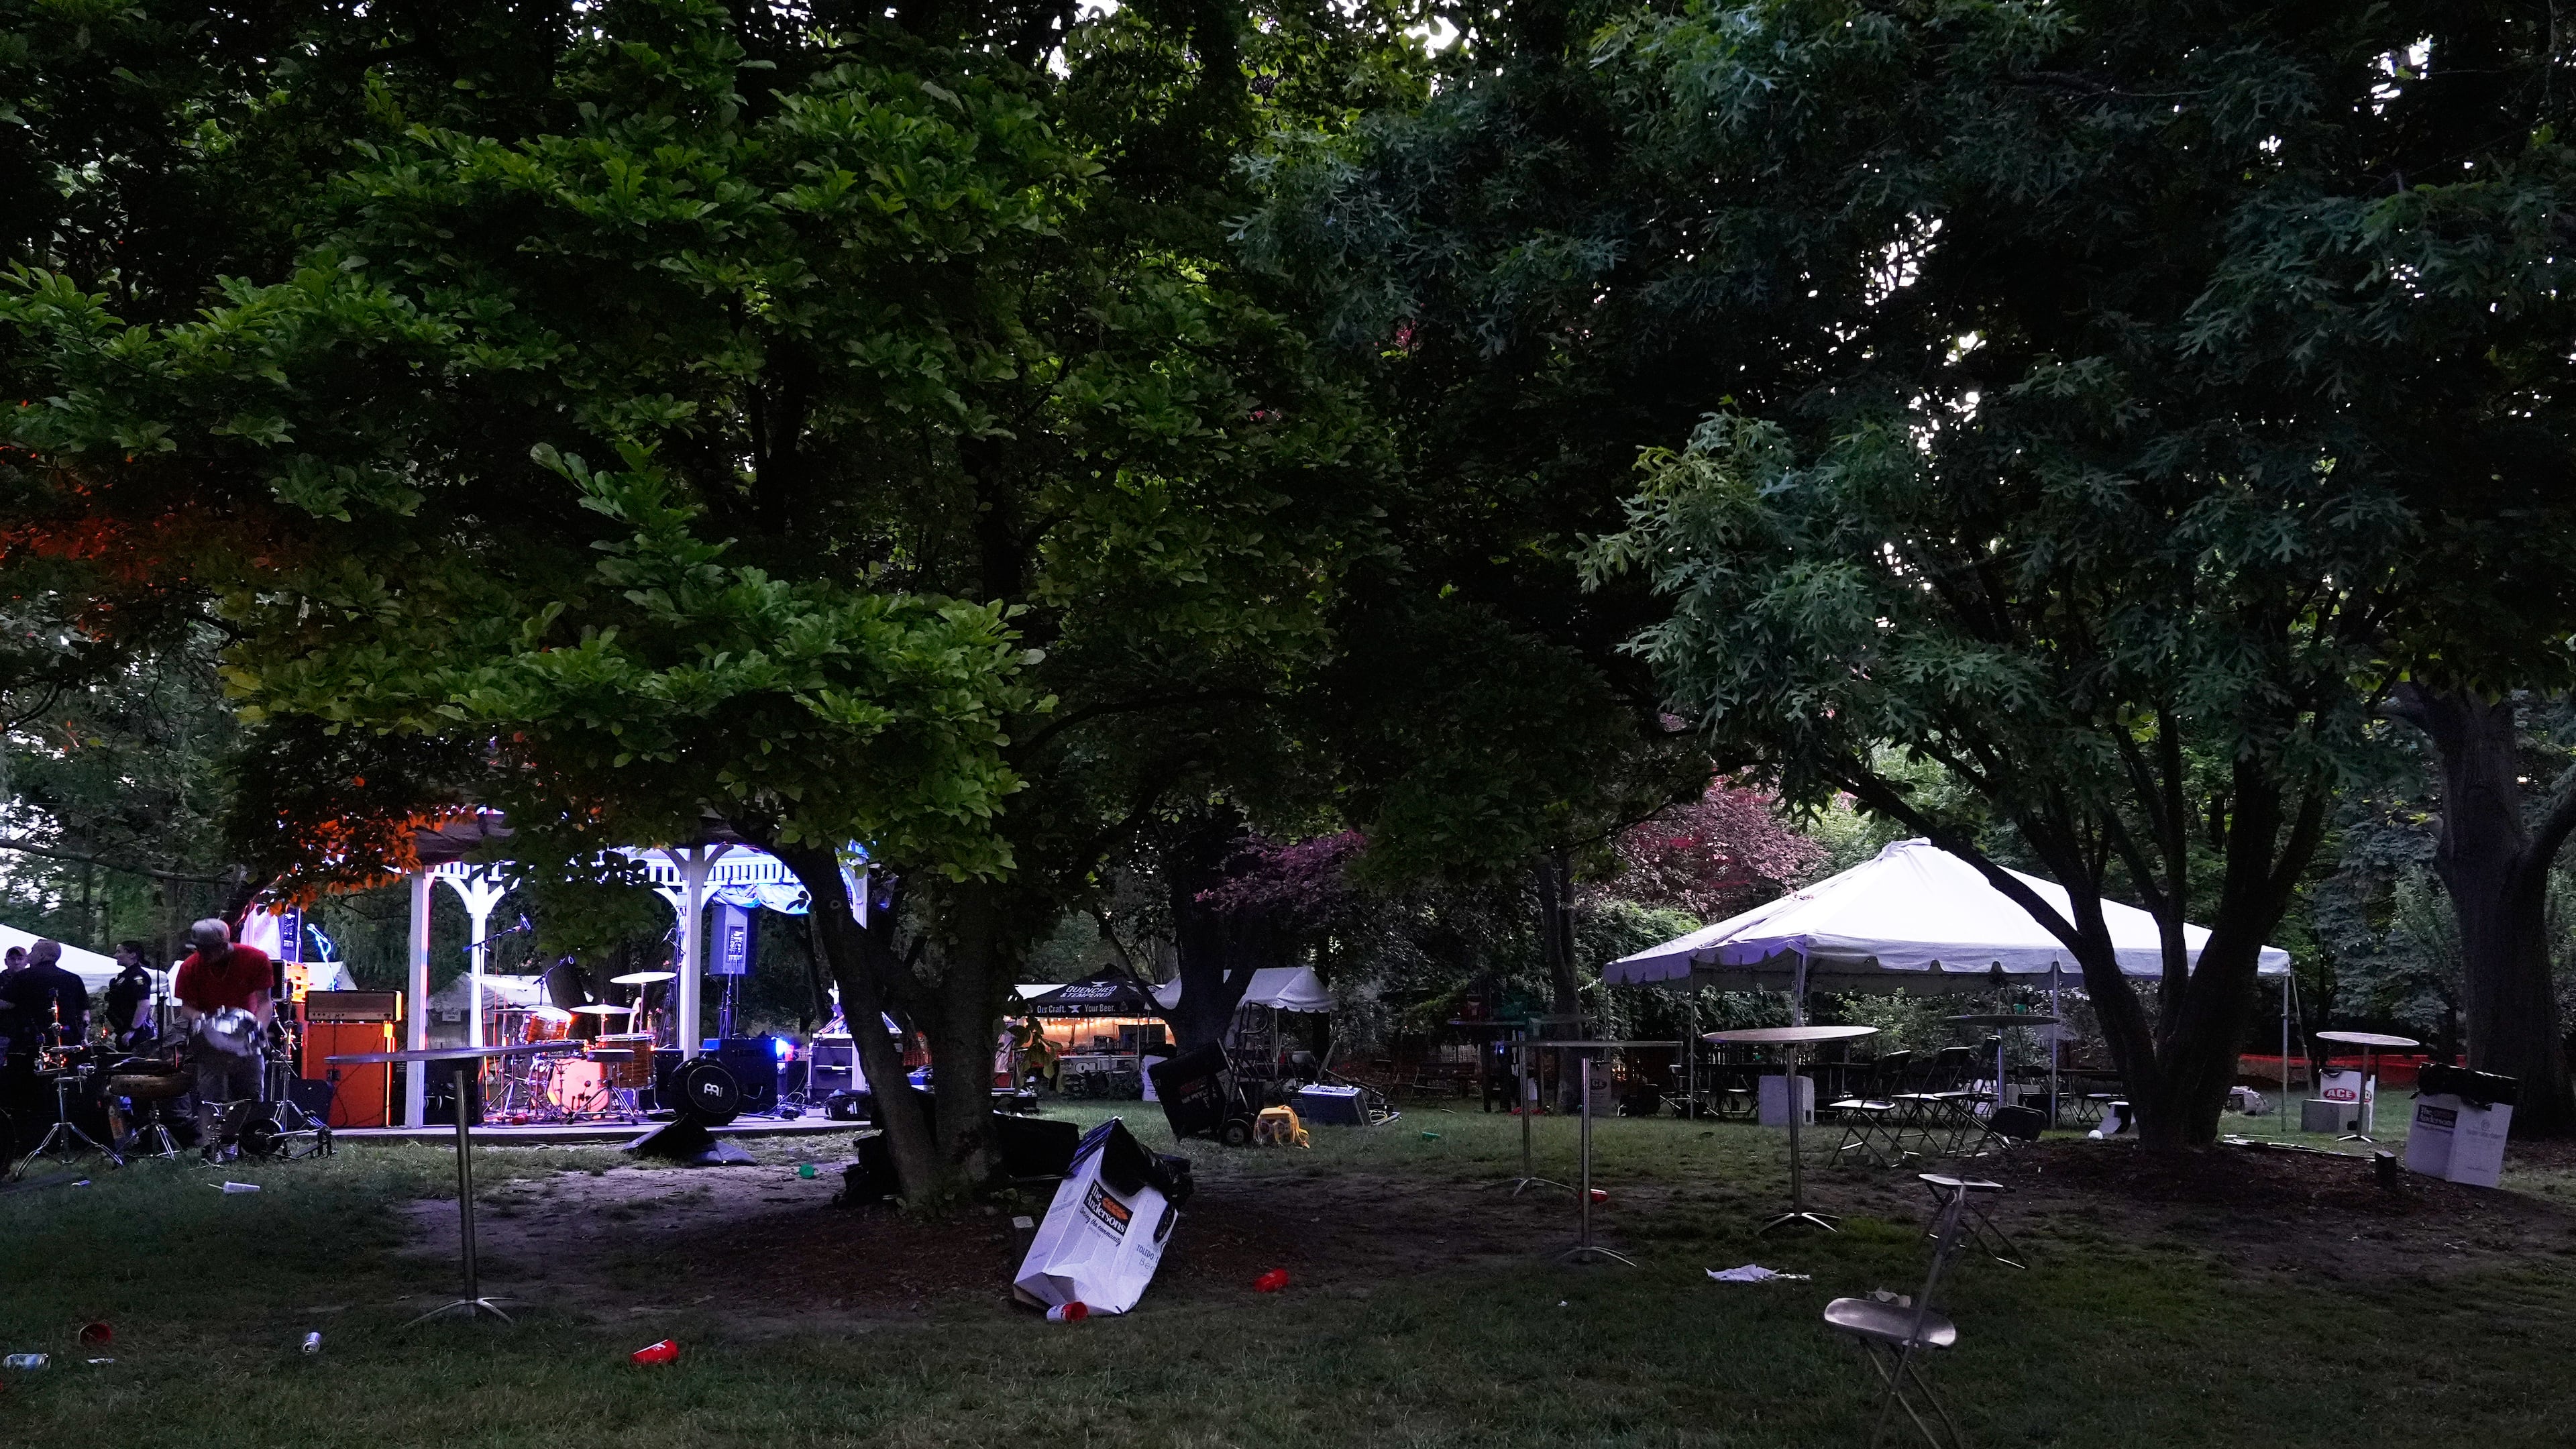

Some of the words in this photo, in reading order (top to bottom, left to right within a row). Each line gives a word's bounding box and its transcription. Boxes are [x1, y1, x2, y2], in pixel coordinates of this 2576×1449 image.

[1065, 985, 1118, 994] QUENCHED
[1036, 1005, 1047, 1014] Our
[1084, 1004, 1099, 1012] Your
[1099, 1004, 1116, 1012] Beer.
[2326, 1089, 2354, 1098] ACE
[1091, 1182, 1103, 1202] The
[1086, 1194, 1127, 1233] Andersons
[1097, 1225, 1122, 1246] community
[1136, 1244, 1155, 1260] TOLEDO
